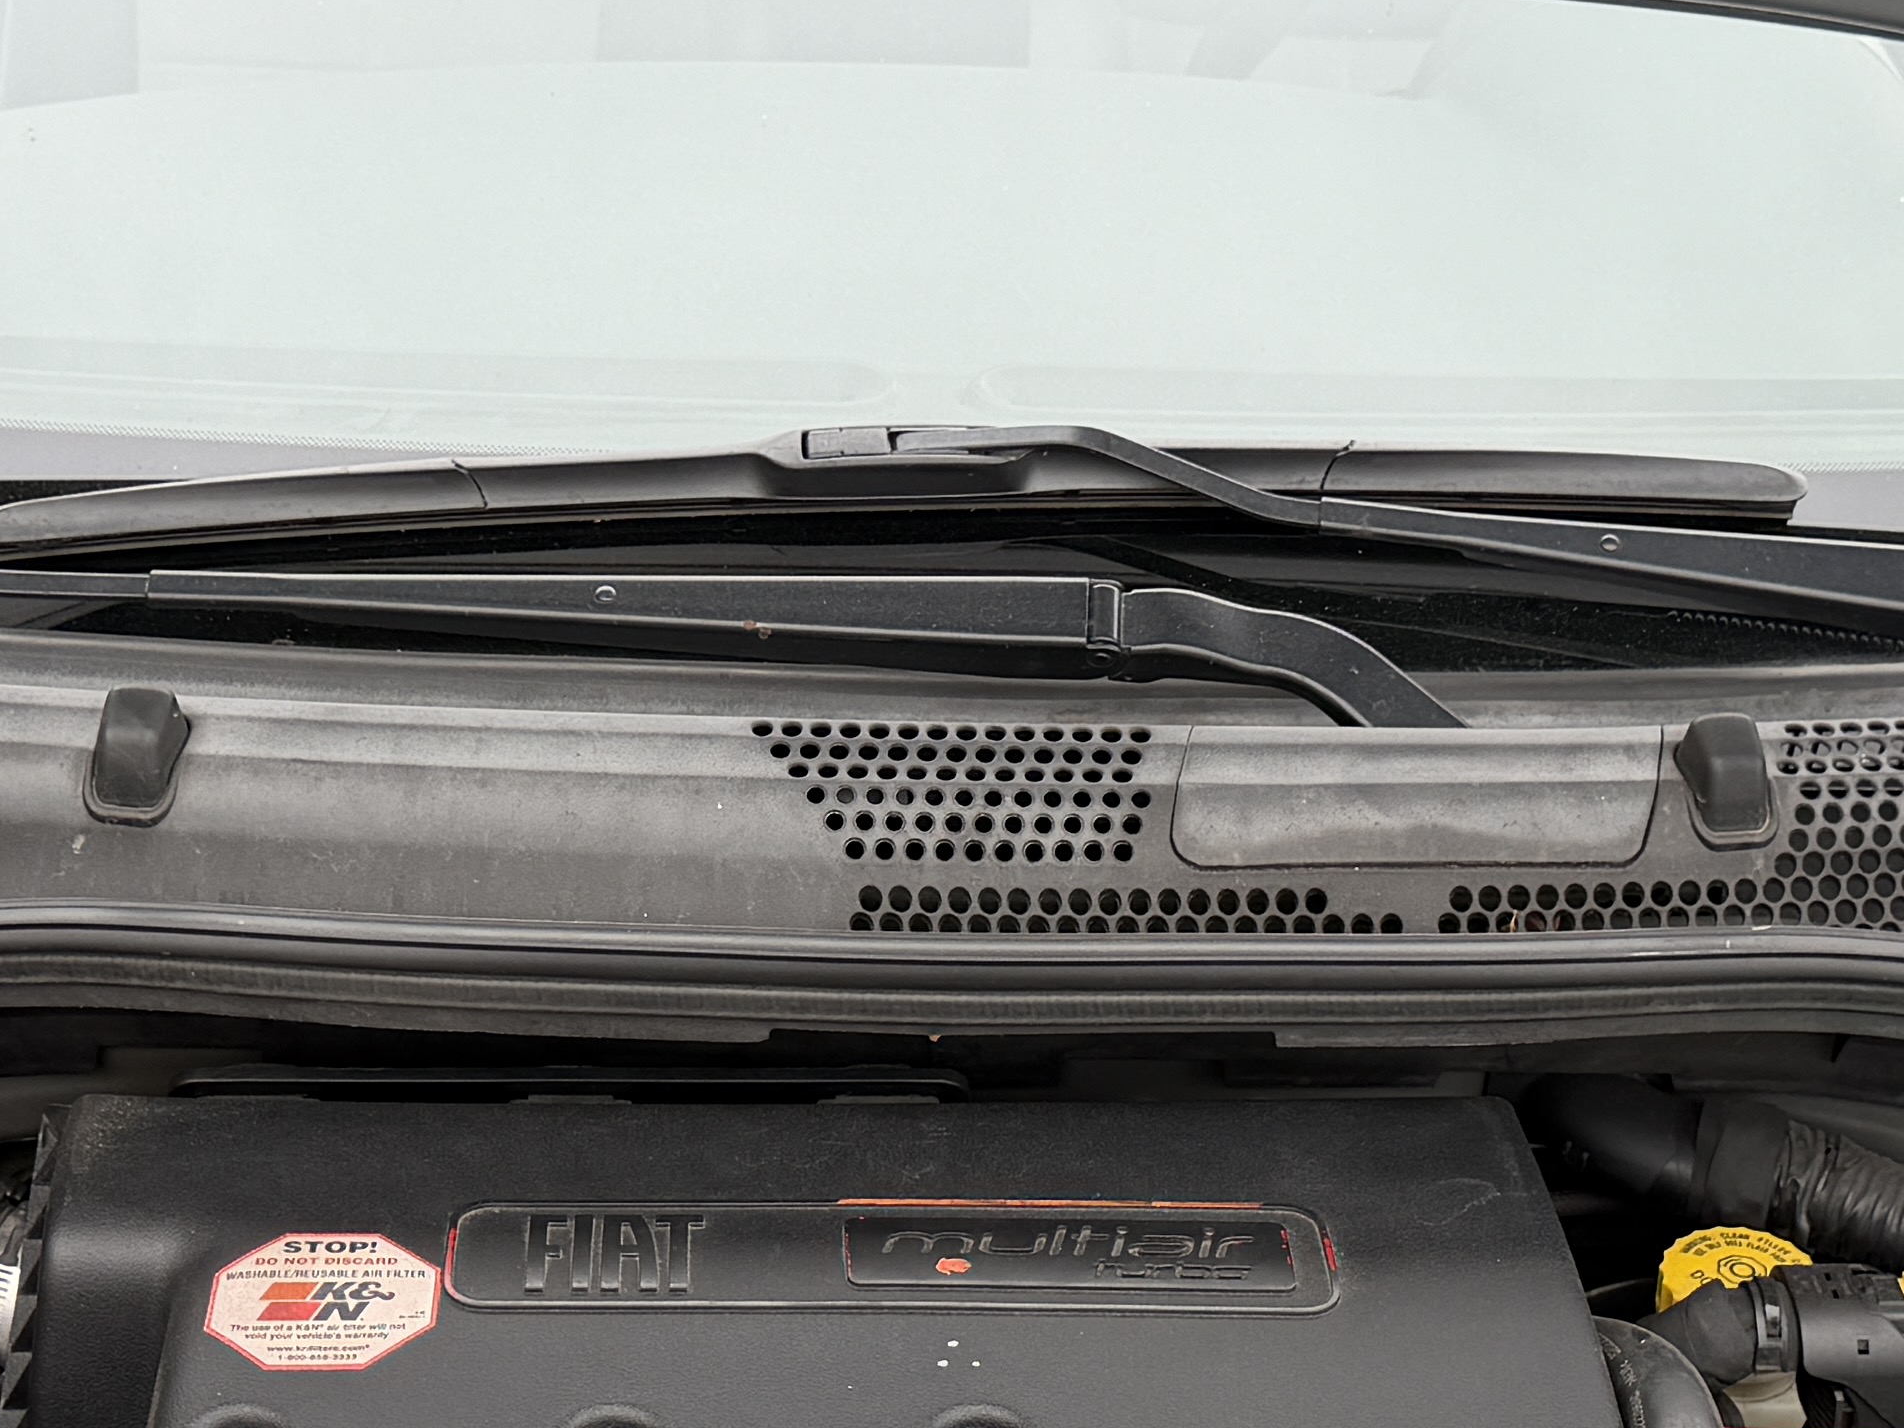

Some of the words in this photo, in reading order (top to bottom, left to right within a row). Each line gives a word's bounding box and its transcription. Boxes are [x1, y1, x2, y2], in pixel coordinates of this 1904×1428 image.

[282, 1240, 378, 1254] STOP!
[881, 1224, 1255, 1259] multiair
[523, 1212, 706, 1295] FIAT
[254, 1257, 278, 1266] DO
[284, 1257, 319, 1266] NOT
[324, 1257, 398, 1266] DISCARD
[225, 1269, 359, 1281] WASHABLE/REUSABLE
[361, 1269, 383, 1279] AIR
[385, 1269, 426, 1279] FILTER
[230, 1324, 250, 1332] The
[269, 1332, 293, 1341] your
